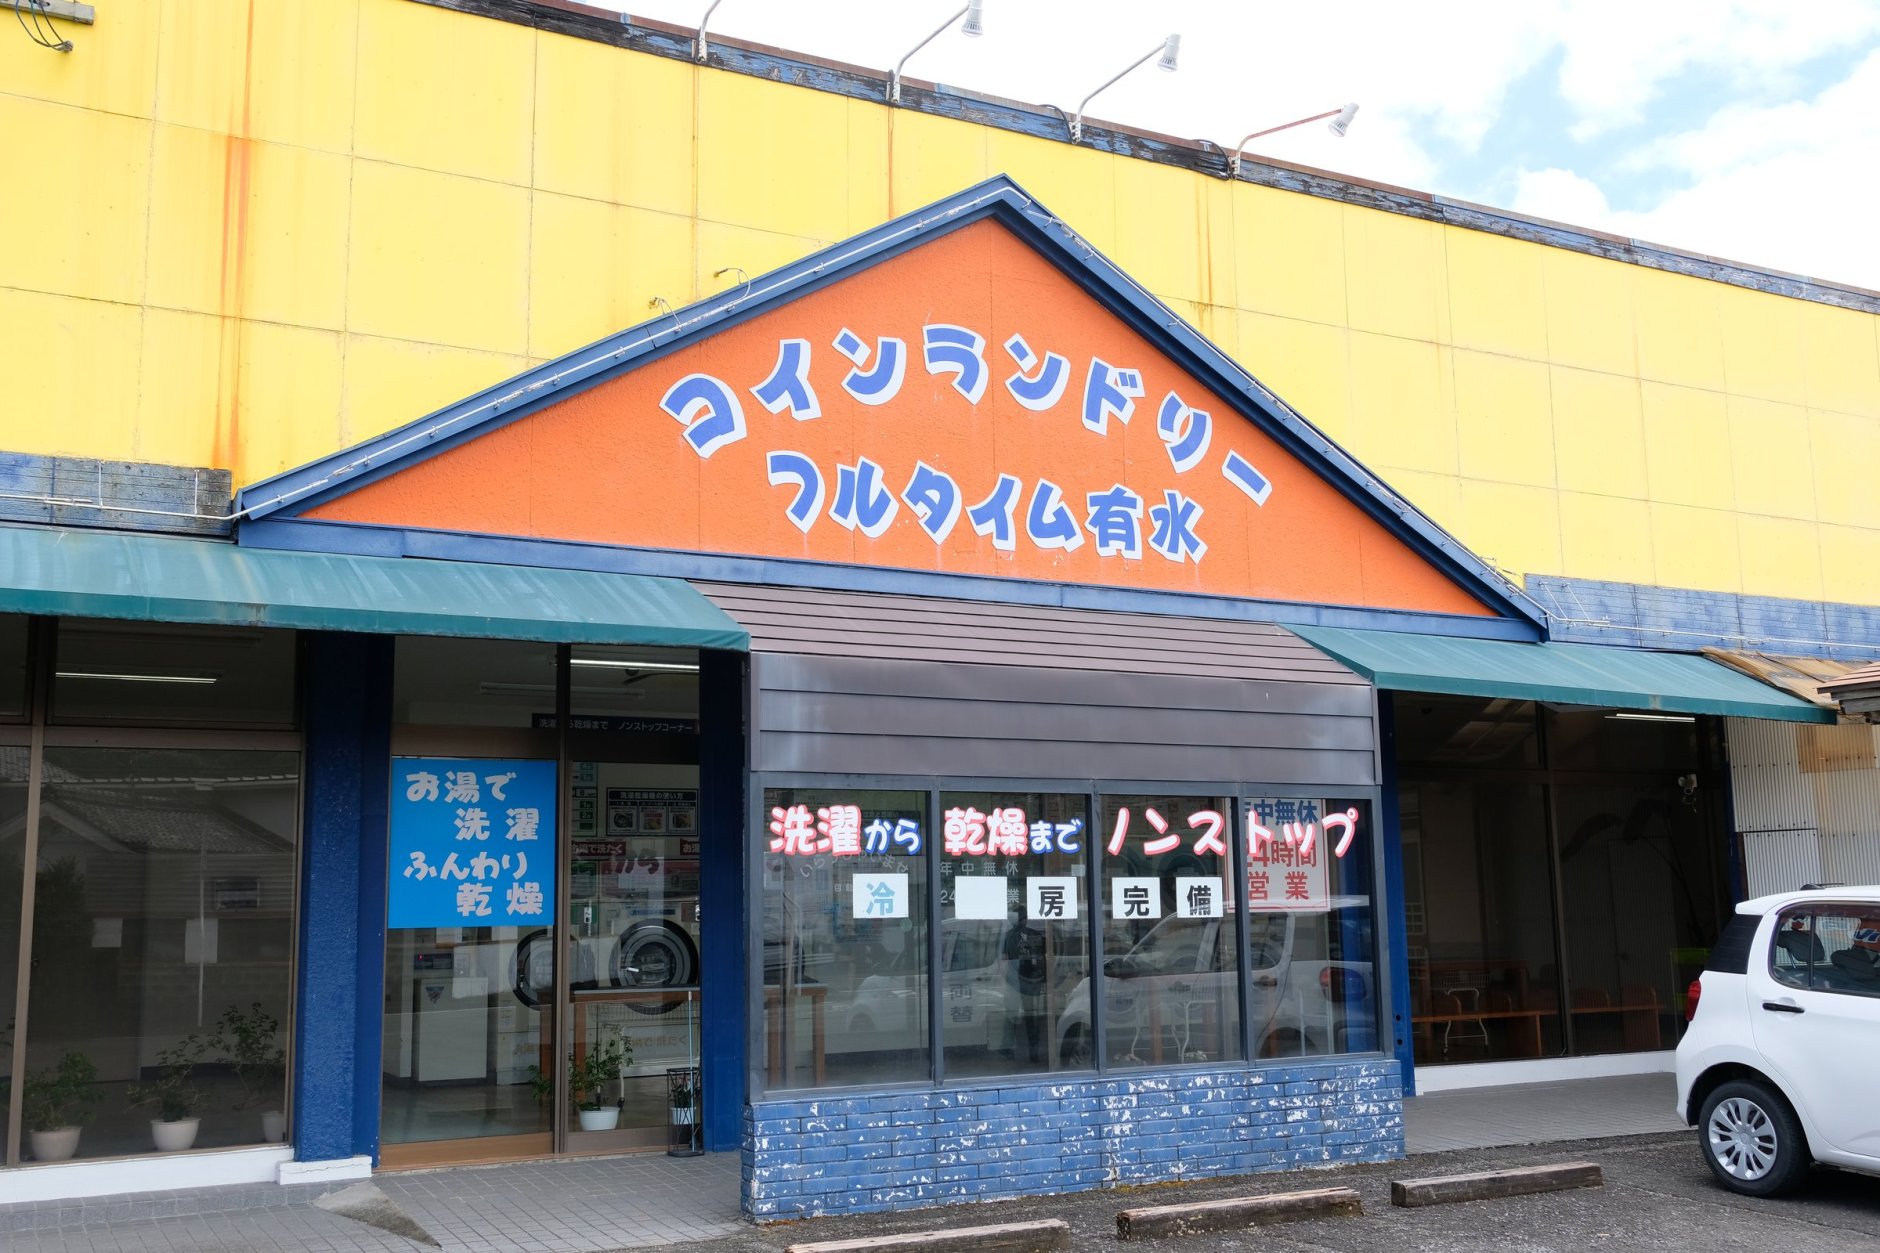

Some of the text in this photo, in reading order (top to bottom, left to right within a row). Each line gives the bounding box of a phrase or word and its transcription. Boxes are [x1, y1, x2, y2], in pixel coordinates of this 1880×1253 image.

[659, 323, 1272, 507] コインランドリー
[766, 449, 1208, 564] フルタイム有水
[406, 771, 517, 803] お湯で
[454, 808, 540, 841] 洗濯
[769, 805, 922, 856] 洗濯から
[944, 807, 1084, 855] 乾燥まで
[1107, 807, 1359, 858] ノンストップ
[403, 851, 528, 880] ふんわり
[939, 860, 1019, 876] 年中無休
[1246, 839, 1317, 868] 4時間
[456, 881, 544, 917] 乾燥
[1038, 885, 1066, 917] 房
[1247, 871, 1310, 901] 営業
